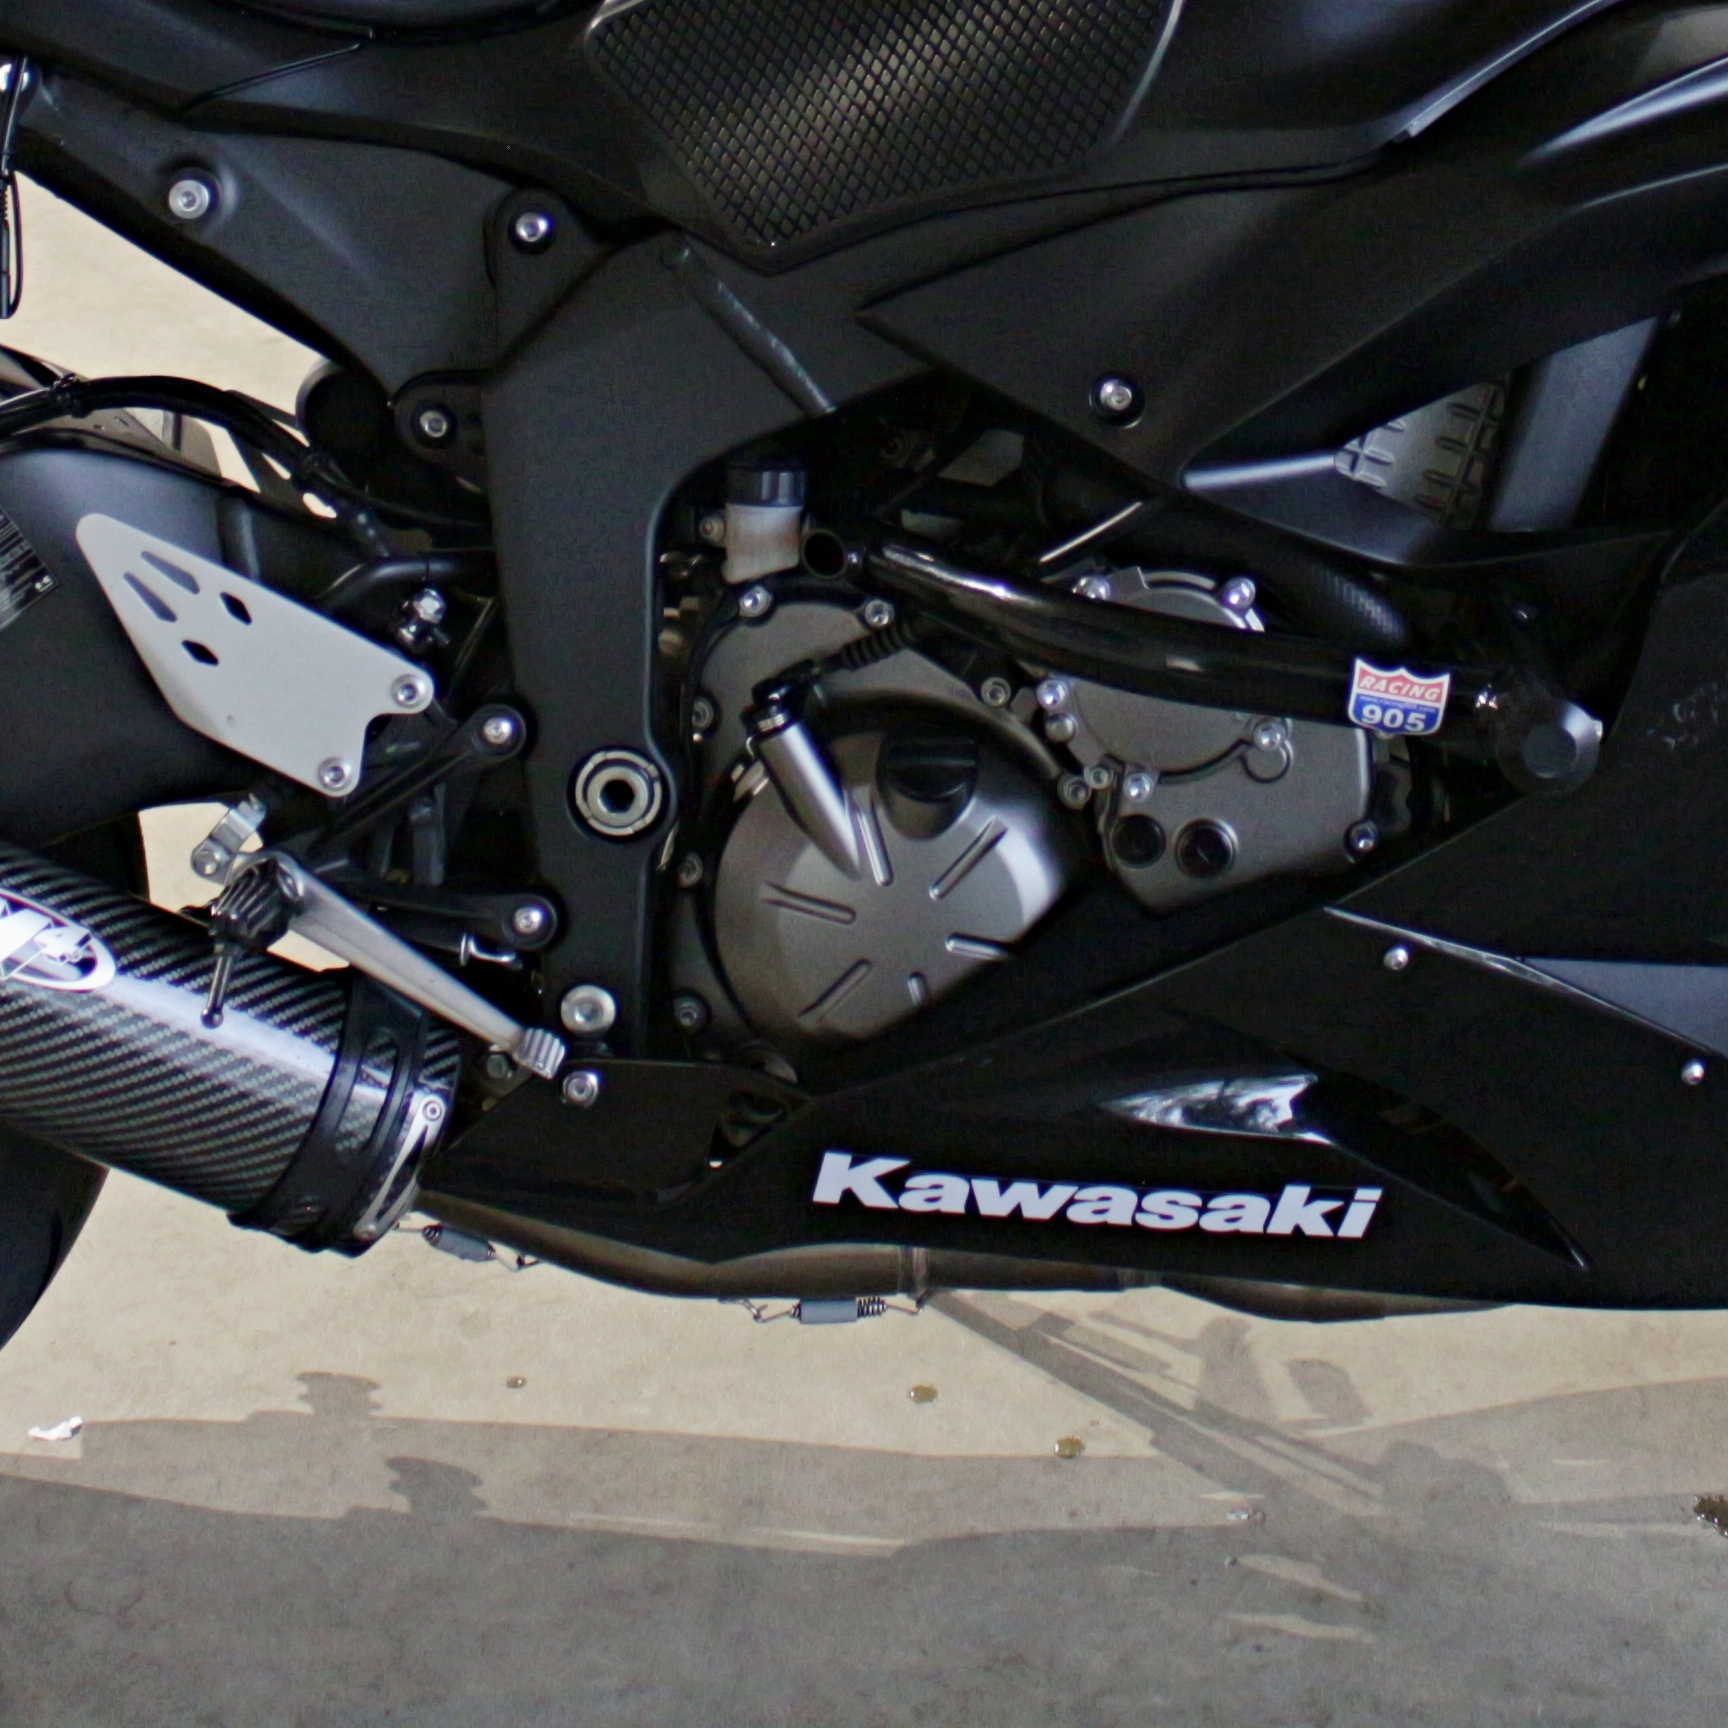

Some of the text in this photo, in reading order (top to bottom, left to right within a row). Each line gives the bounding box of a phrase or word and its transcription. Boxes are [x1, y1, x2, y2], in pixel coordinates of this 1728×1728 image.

[1359, 675, 1441, 702] RACING
[1360, 704, 1427, 732] 905
[811, 1150, 1384, 1240] Kawasaki
